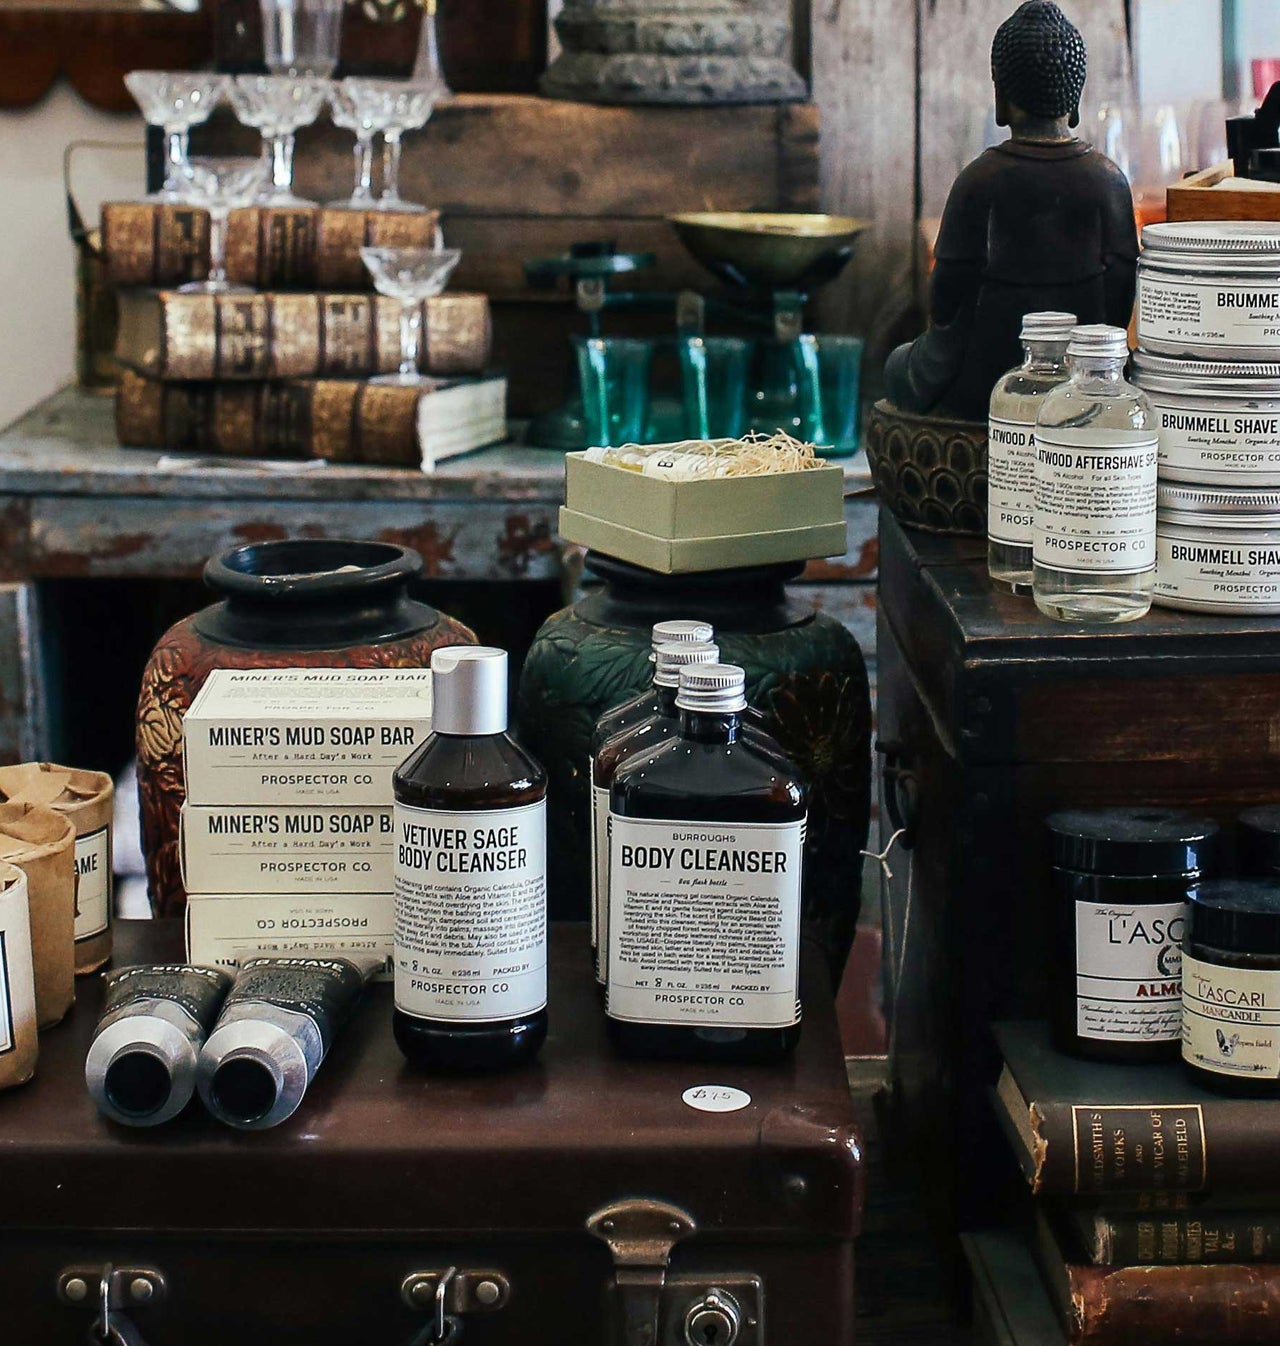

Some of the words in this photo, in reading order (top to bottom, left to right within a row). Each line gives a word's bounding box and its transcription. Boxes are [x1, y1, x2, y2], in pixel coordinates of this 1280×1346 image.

[1162, 414, 1230, 433] BRUMMELL
[1234, 417, 1278, 434] SHAVE
[1075, 454, 1143, 470] AFTERSHAVE
[1200, 452, 1265, 461] PROSPECTOR
[1045, 537, 1127, 553] PROSPECTOR
[1171, 545, 1245, 565] BRUMMELL
[1213, 584, 1278, 592] PROSPECTOR
[304, 674, 341, 682] MUD
[347, 674, 389, 682] SOAP
[394, 673, 427, 681] BAR
[209, 727, 280, 747] MINER'S
[286, 727, 325, 747] MUD
[330, 727, 375, 746] SOAP
[381, 727, 414, 745] BAR
[252, 753, 279, 762] After
[351, 752, 373, 760] Work
[261, 775, 348, 785] PROSPECTOR
[208, 815, 279, 834] MINER'S
[285, 815, 324, 834] MUD
[329, 815, 374, 833] SOAP
[403, 823, 467, 850] VETIVER
[473, 826, 519, 848] SAGE
[673, 832, 736, 843] BURROUGHS
[74, 853, 98, 875] AME
[399, 844, 432, 869] BODY
[437, 848, 527, 873] CLEANSER
[622, 845, 674, 868] BODY
[681, 849, 787, 873] CLEANSER
[261, 862, 347, 872] PROSPECTOR
[282, 918, 368, 929] PROSPECTOR
[411, 979, 487, 995] PROSPECTOR
[1198, 982, 1265, 1007] L'ASCARI
[655, 994, 724, 1006] PROSPECTOR
[1202, 1004, 1261, 1023] MANCANDLE
